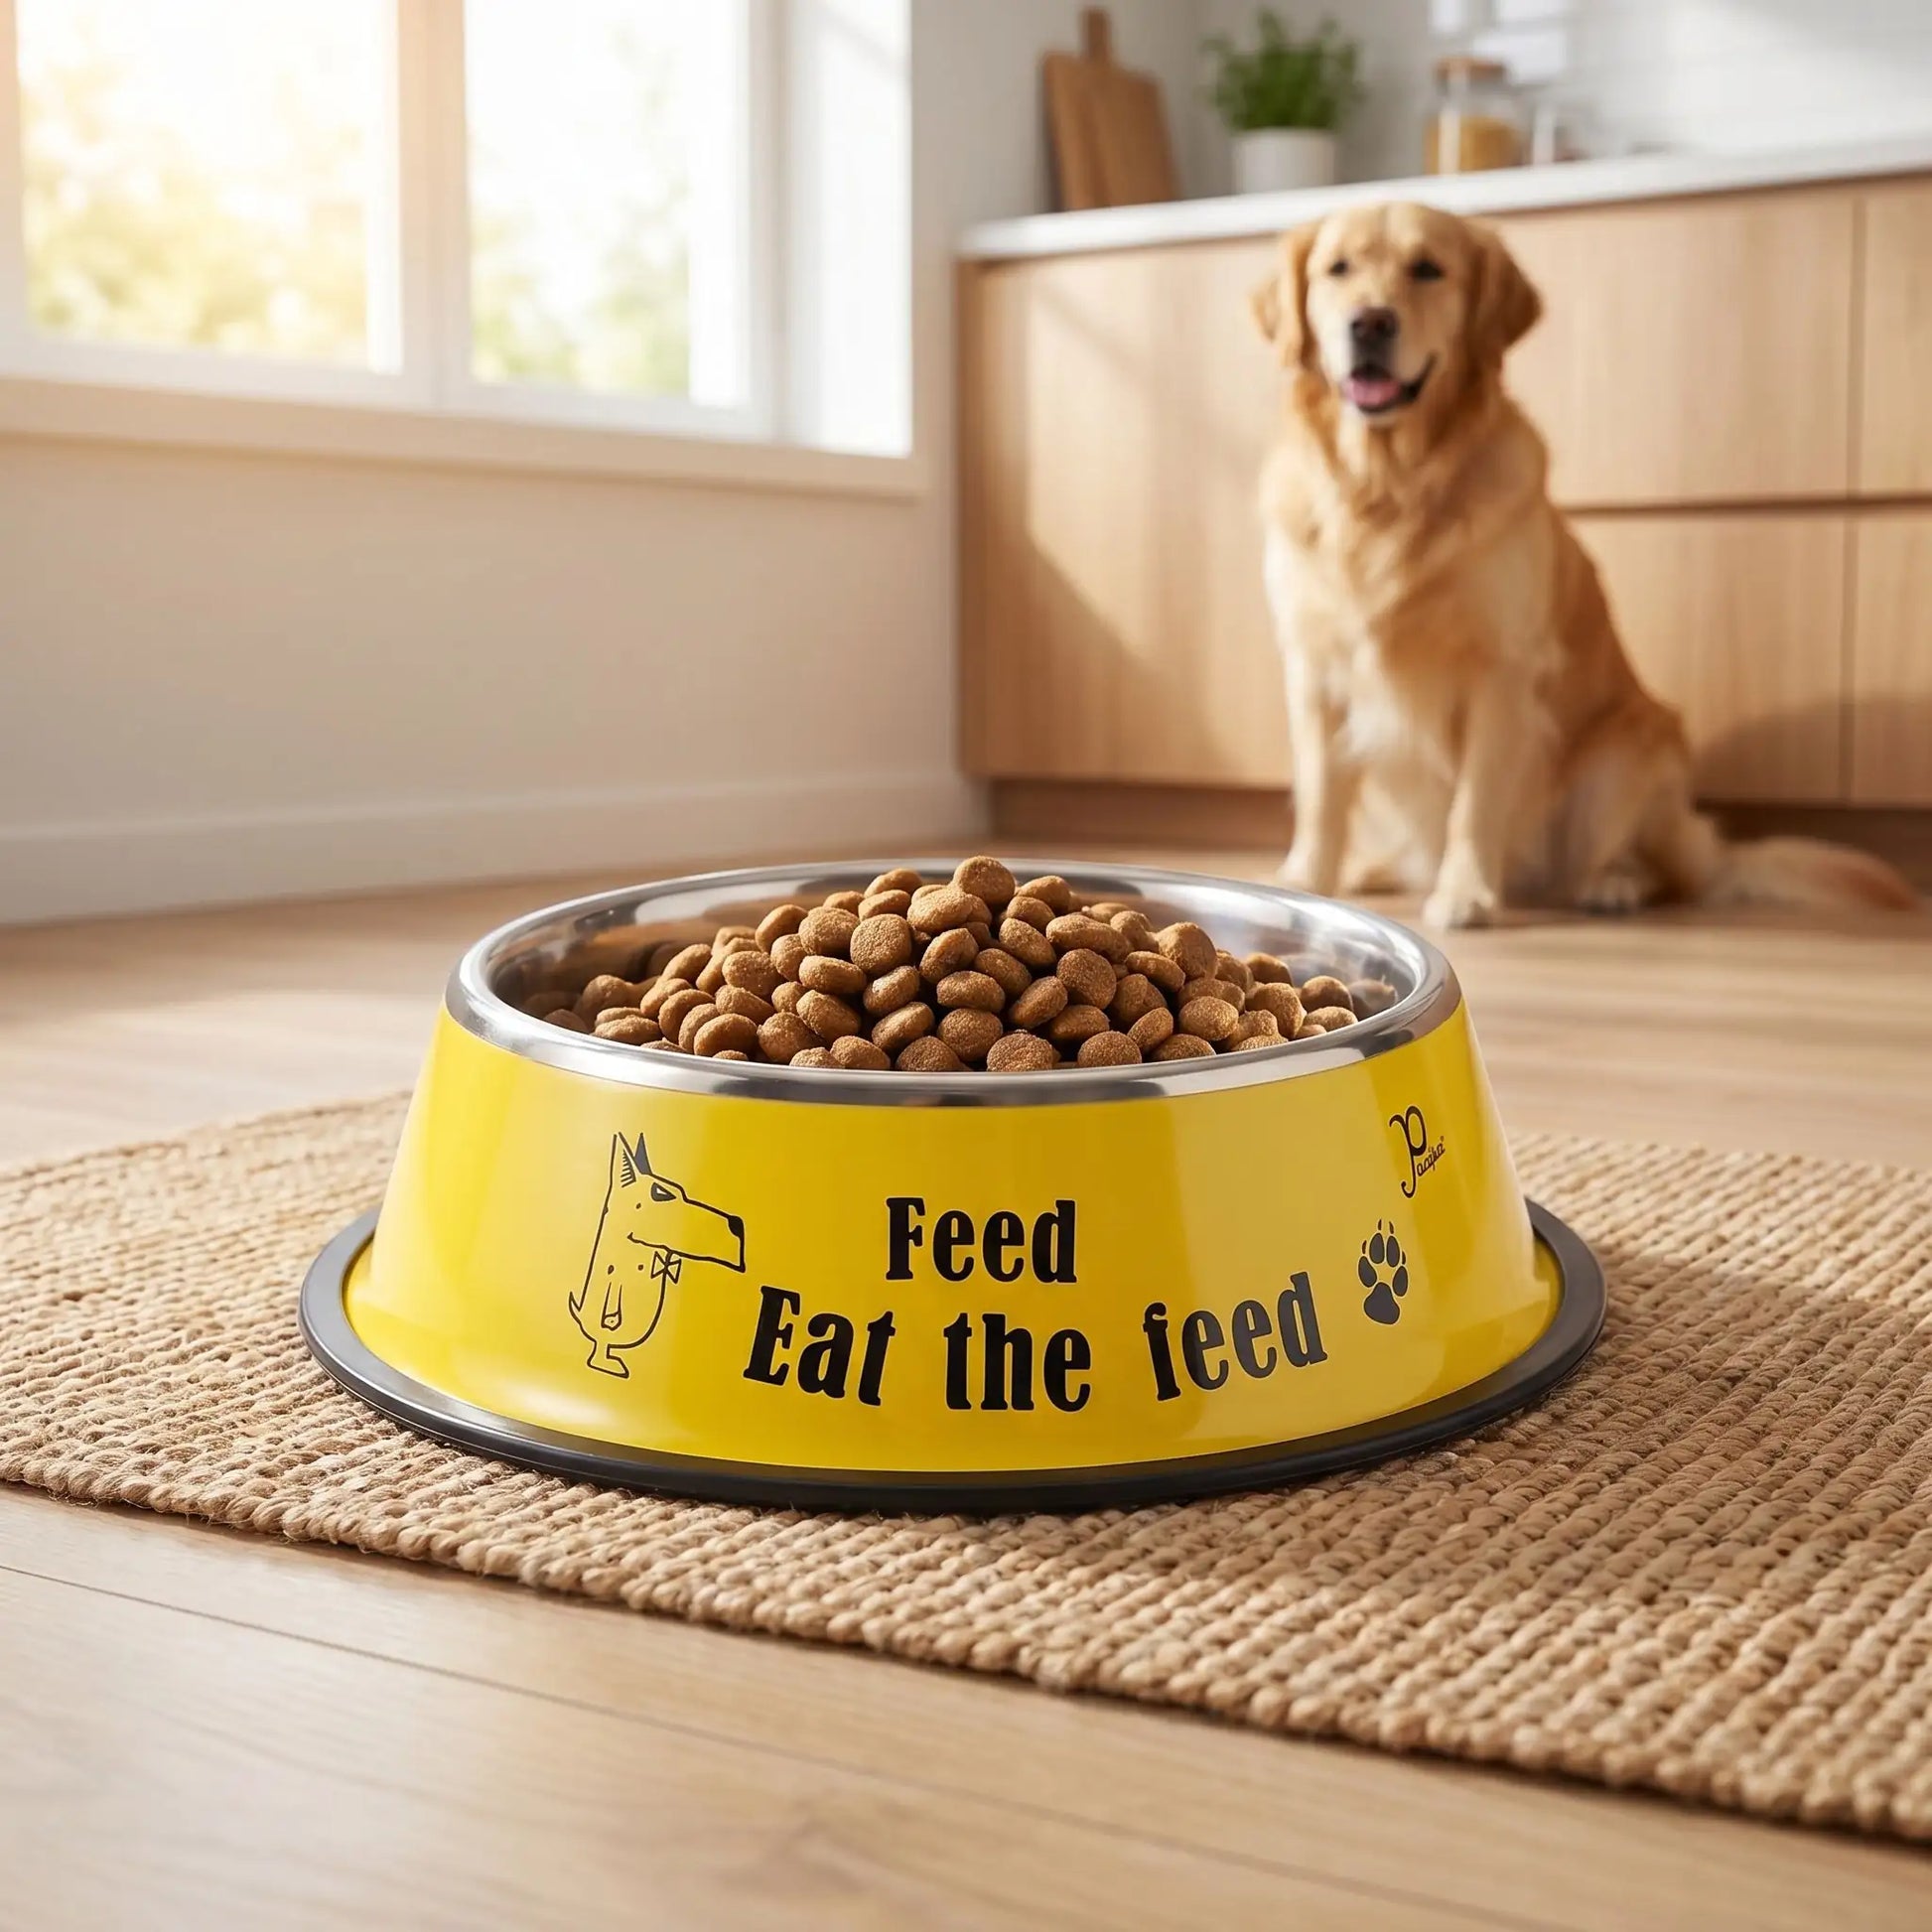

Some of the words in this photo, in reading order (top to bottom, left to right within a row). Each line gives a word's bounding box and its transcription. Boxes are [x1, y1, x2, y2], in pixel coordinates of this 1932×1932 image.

[885, 1196, 1077, 1284] Feed
[743, 1285, 896, 1407] Eat
[943, 1311, 1091, 1413] the
[1142, 1271, 1328, 1402] feed
